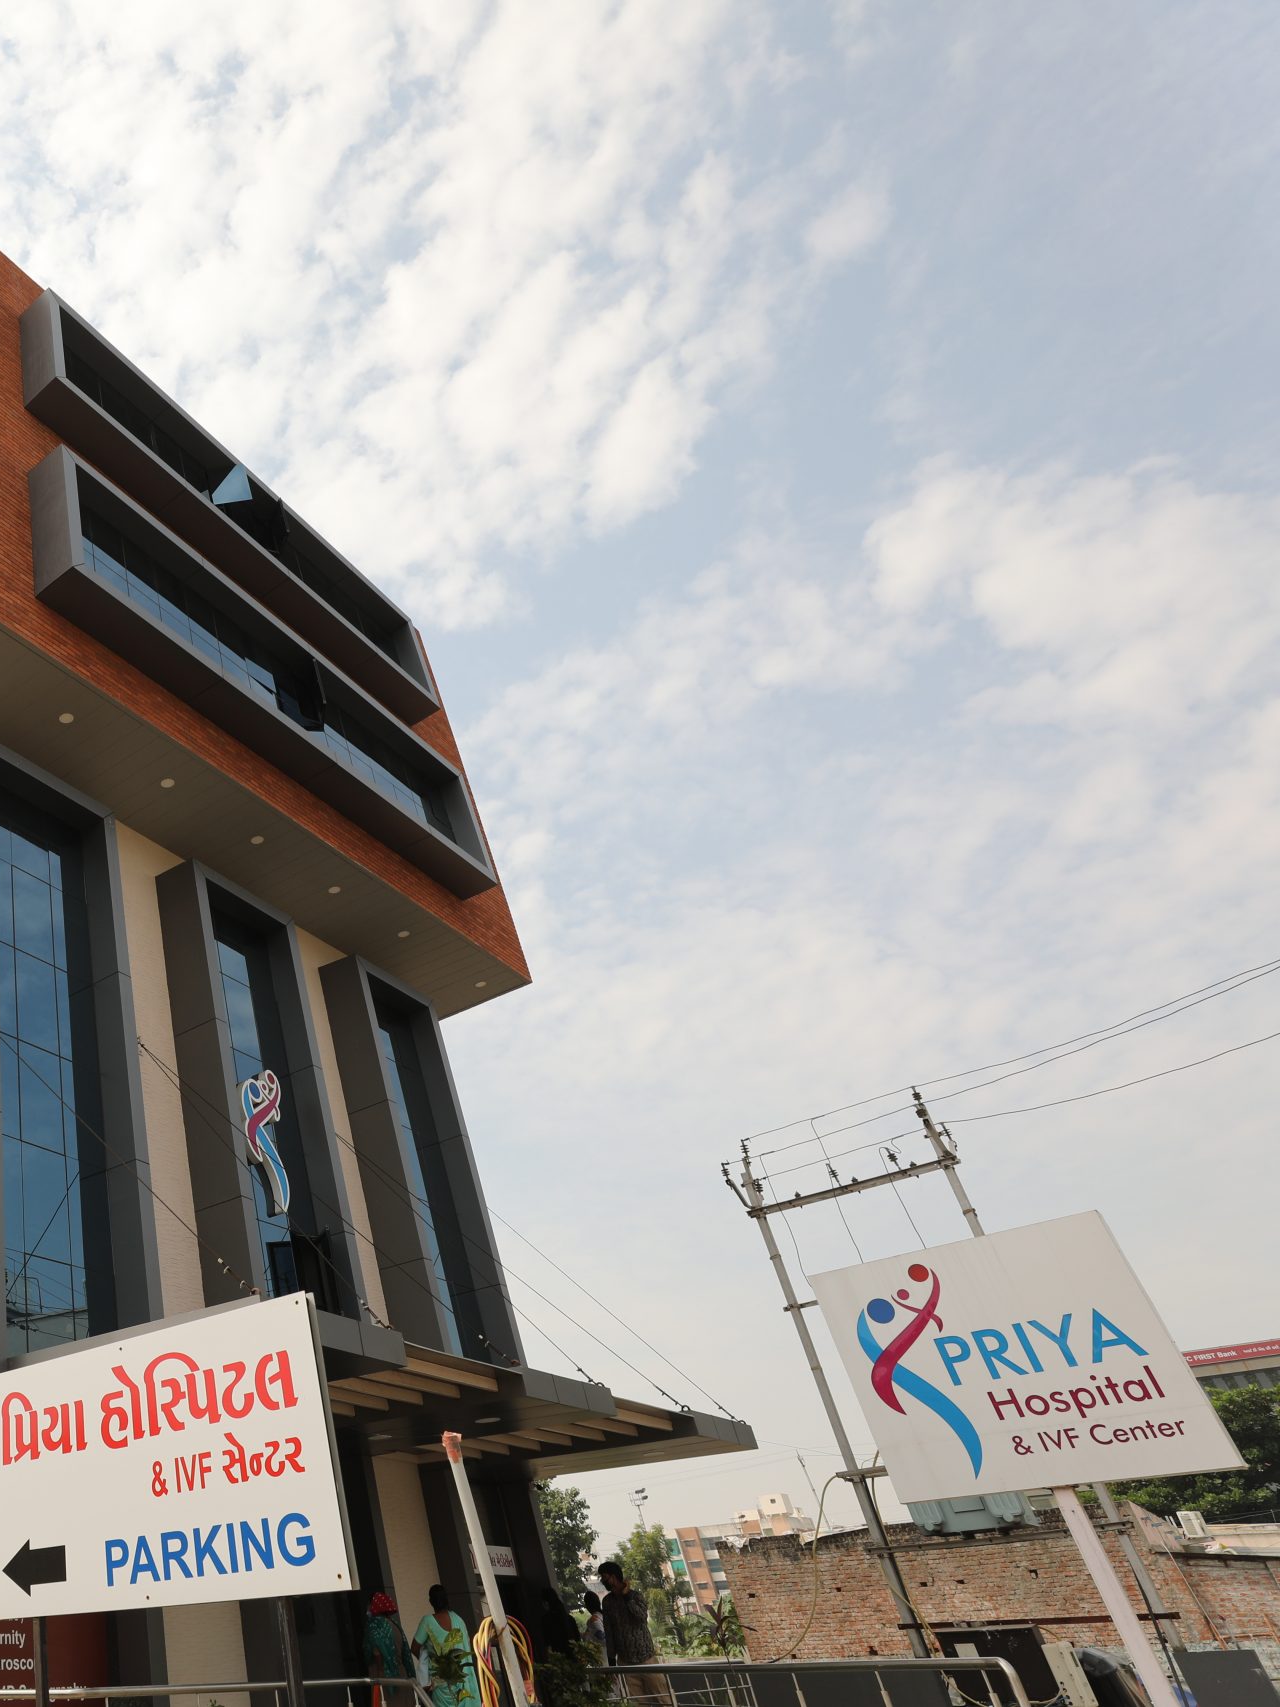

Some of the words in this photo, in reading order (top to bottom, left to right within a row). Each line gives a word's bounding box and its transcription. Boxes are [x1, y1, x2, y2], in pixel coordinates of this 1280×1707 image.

[933, 1308, 1149, 1386] PRIYA
[1193, 1352, 1216, 1361] FIRST
[1217, 1350, 1238, 1359] Bank
[2, 1391, 88, 1466] પ્રિયા
[101, 1351, 299, 1450] હોસ્પિટલ
[987, 1366, 1166, 1420] Hospital
[152, 1460, 169, 1498] &
[175, 1451, 213, 1494] IVF
[222, 1432, 306, 1485] સેન્ટર
[1012, 1435, 1033, 1456] &
[1038, 1427, 1081, 1453] IVF
[1089, 1419, 1185, 1446] Center
[105, 1512, 317, 1588] PARKING
